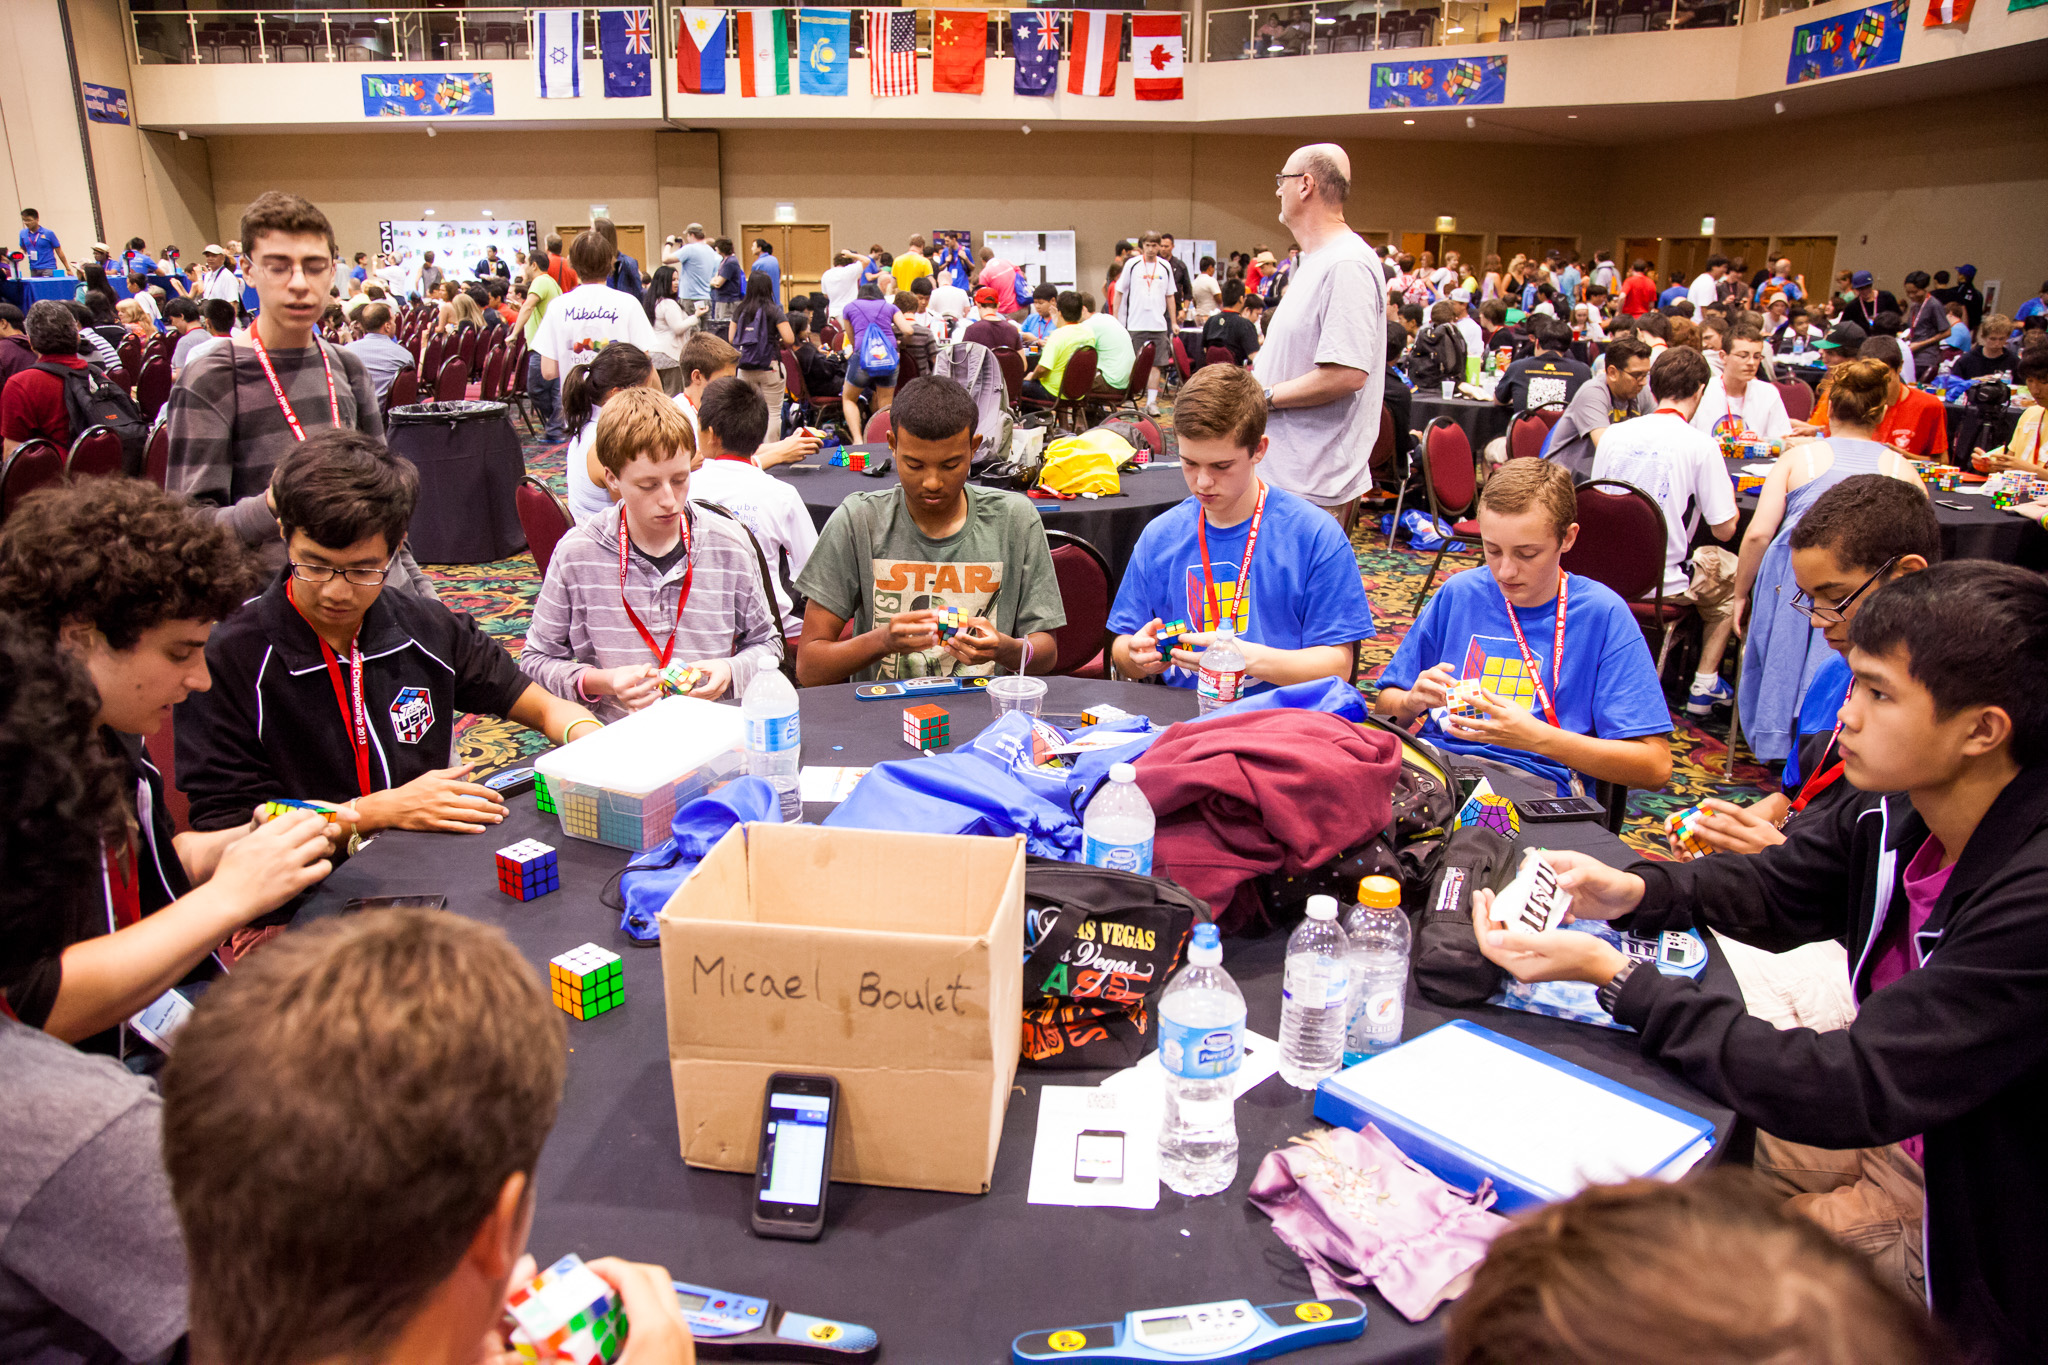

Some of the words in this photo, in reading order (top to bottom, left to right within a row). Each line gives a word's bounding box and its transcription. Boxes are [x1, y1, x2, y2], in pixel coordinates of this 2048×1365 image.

[1246, 539, 1255, 557] World
[876, 563, 1002, 594] STAR
[1235, 556, 1250, 600] Championship
[353, 668, 364, 726] Championship
[399, 705, 429, 732] USA
[357, 726, 367, 745] 2013
[1101, 922, 1156, 952] VEGAS
[1071, 941, 1155, 992] Vegas
[692, 954, 822, 1002] Micael
[857, 971, 972, 1017] Boulet
